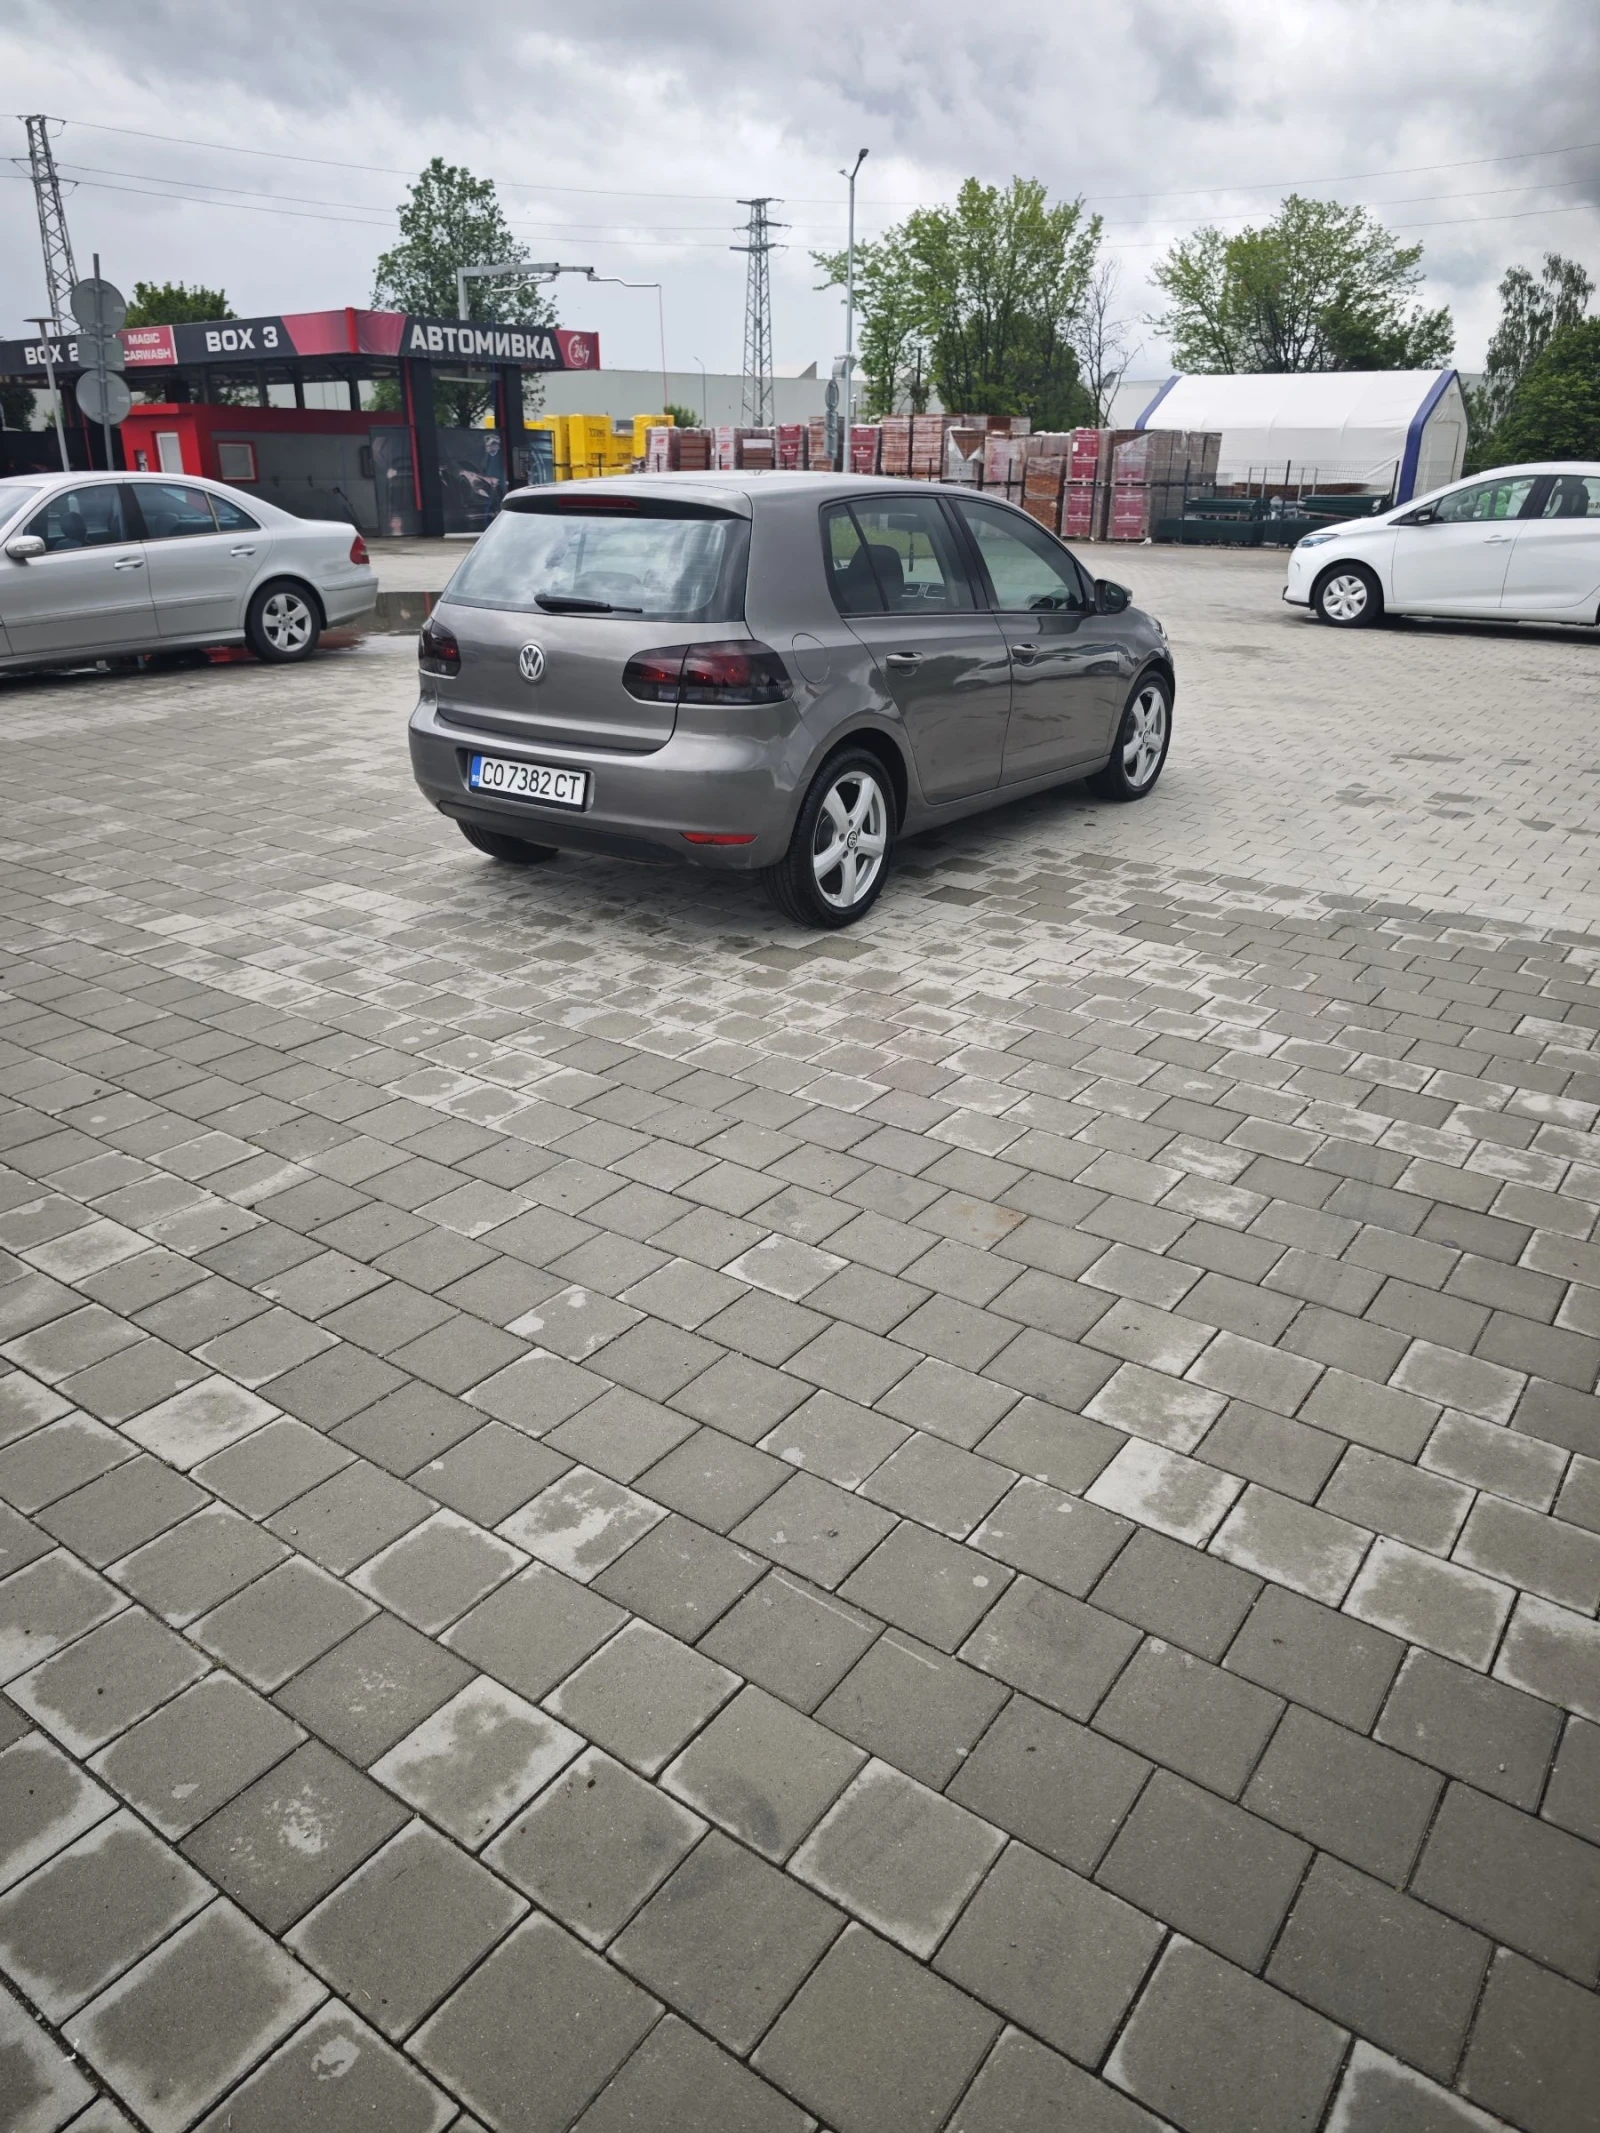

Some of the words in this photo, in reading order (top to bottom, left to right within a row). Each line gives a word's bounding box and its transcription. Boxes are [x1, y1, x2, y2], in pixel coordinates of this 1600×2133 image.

[127, 332, 161, 345] MAGIC
[204, 327, 256, 353] BOX
[262, 325, 279, 349] 3
[410, 324, 556, 360] АВТОМИВКА
[24, 344, 64, 366] BOX
[68, 342, 79, 362] 2
[124, 348, 171, 362] CARWASH
